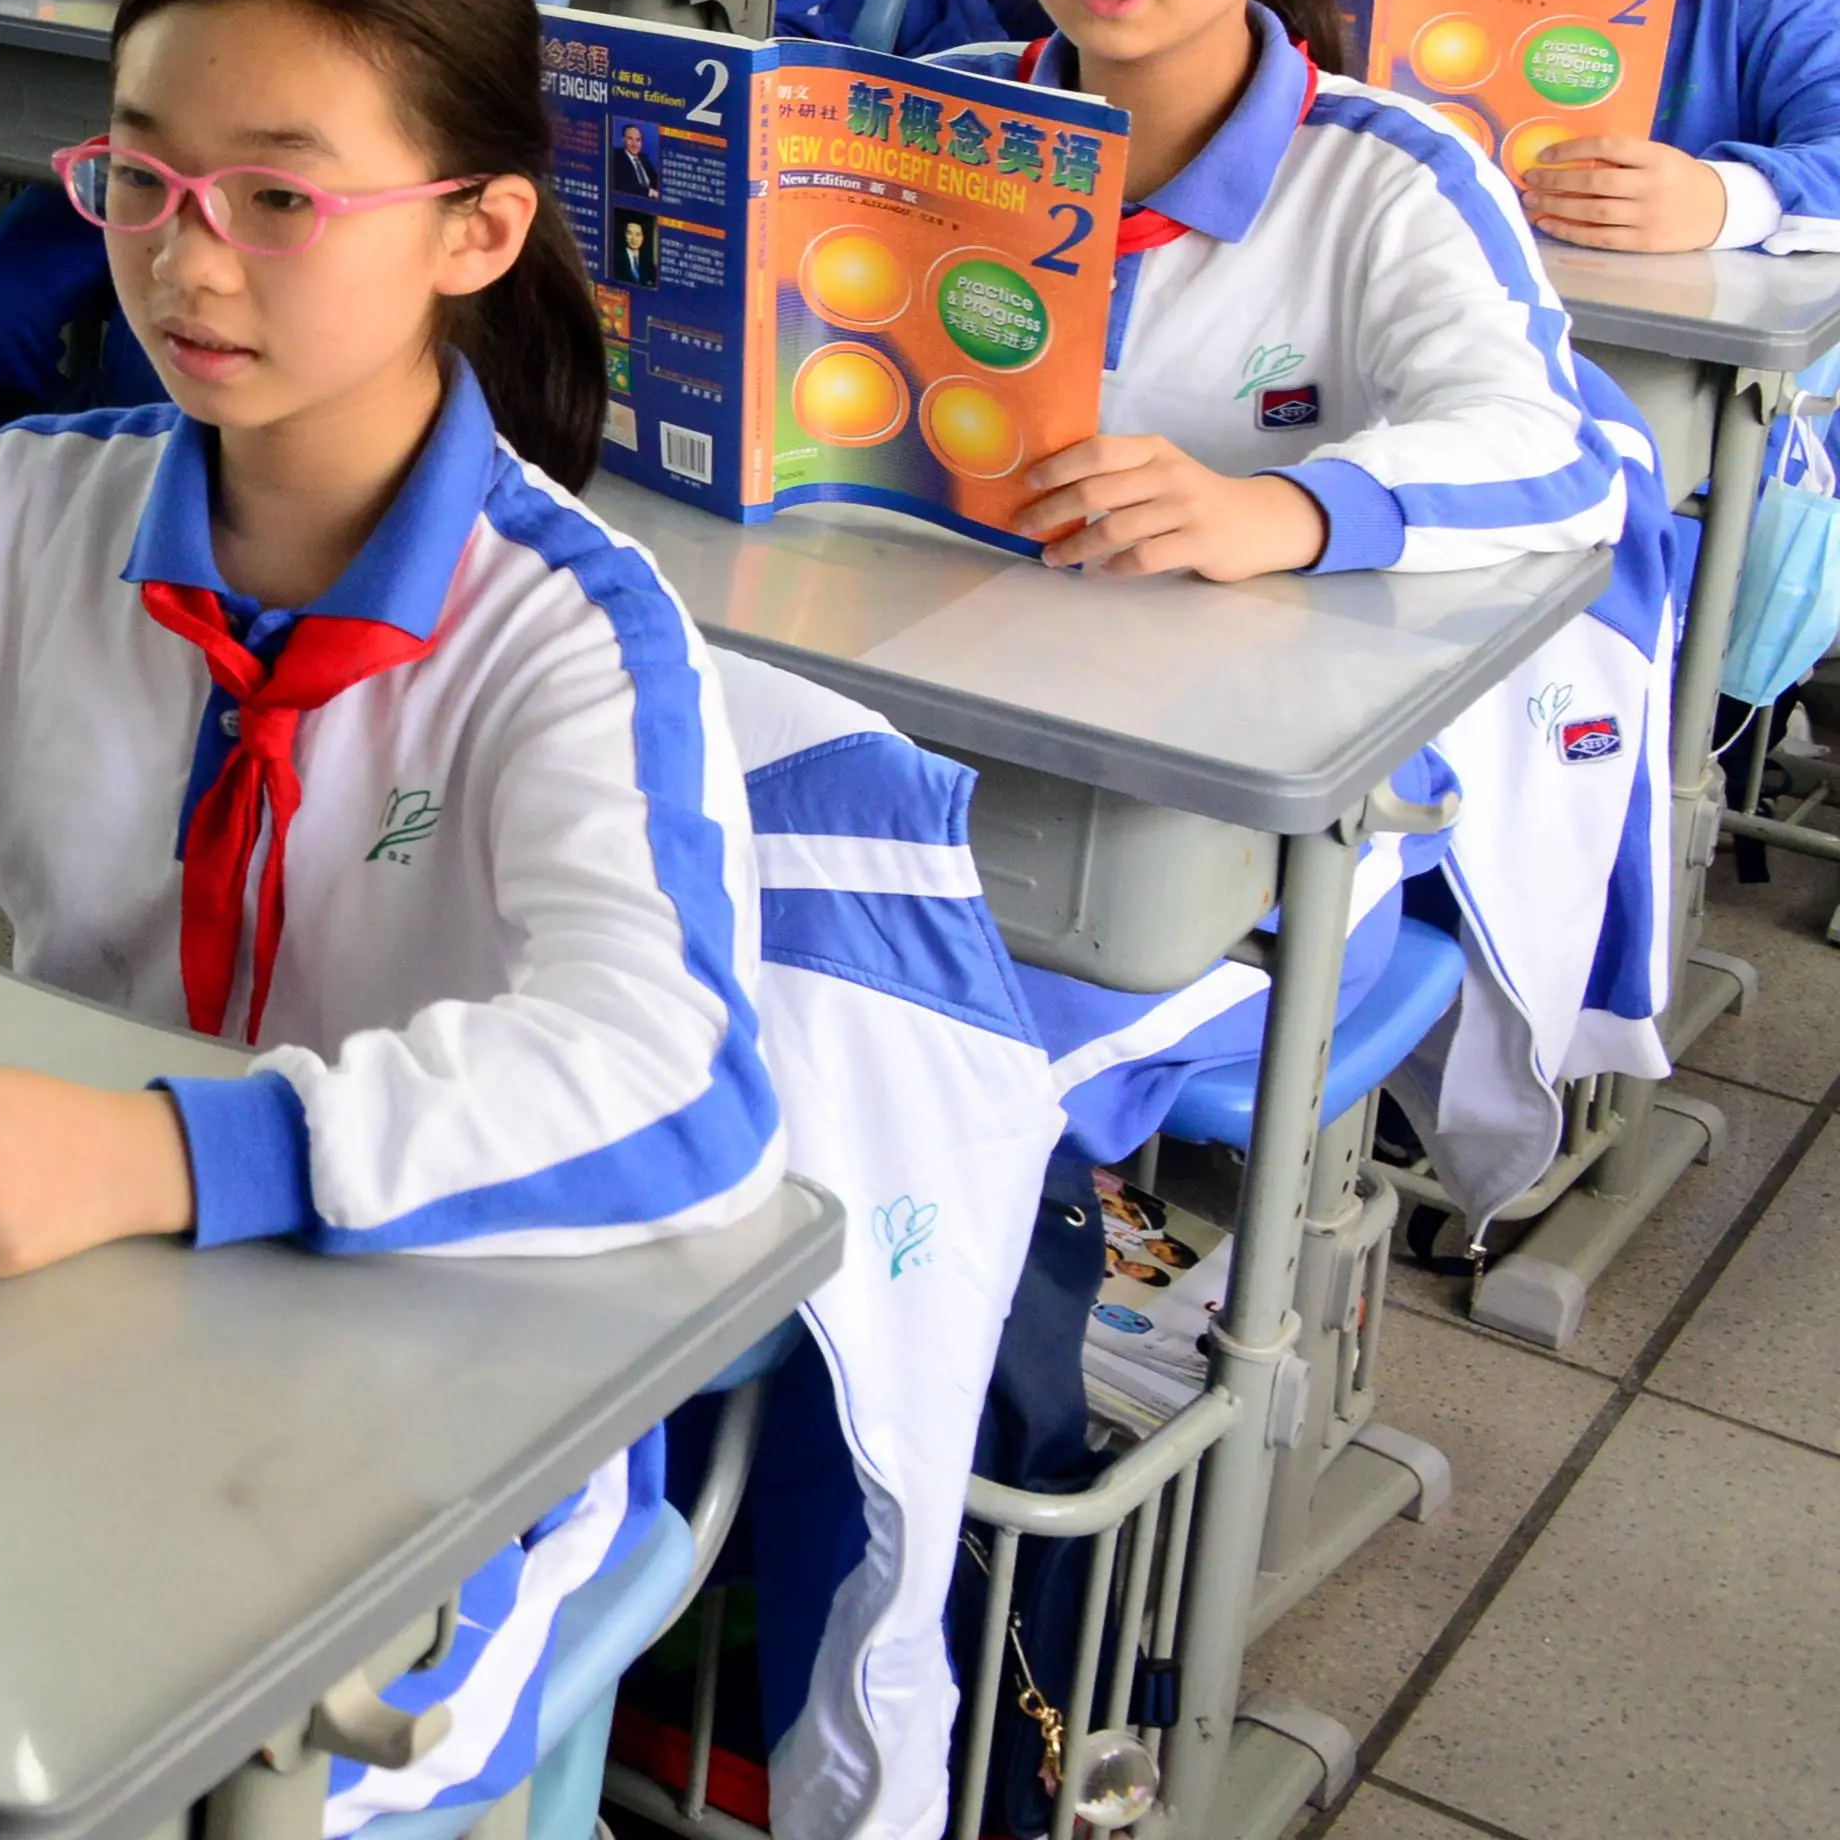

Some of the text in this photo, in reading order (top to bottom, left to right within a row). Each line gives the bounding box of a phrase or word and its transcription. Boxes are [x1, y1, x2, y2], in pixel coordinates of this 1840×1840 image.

[1532, 52, 1614, 73] & Progress
[1542, 41, 1609, 57] Practice
[560, 77, 608, 104] ENGLISH
[686, 59, 729, 126] 2
[778, 85, 809, 100] 朗文
[1532, 68, 1611, 89] 实践与进步
[612, 87, 686, 107] (New Edition)
[779, 104, 839, 121] 外研社
[846, 79, 1102, 196] 新概念英语
[757, 179, 768, 198] 2
[778, 135, 1028, 214] NEW CONCEPT ENGLISH
[779, 173, 918, 205] New Edition 新版
[1031, 202, 1095, 277] 2
[957, 277, 1034, 312] Practice
[946, 291, 1042, 333] & Progress
[946, 311, 1037, 352] 实践与进步
